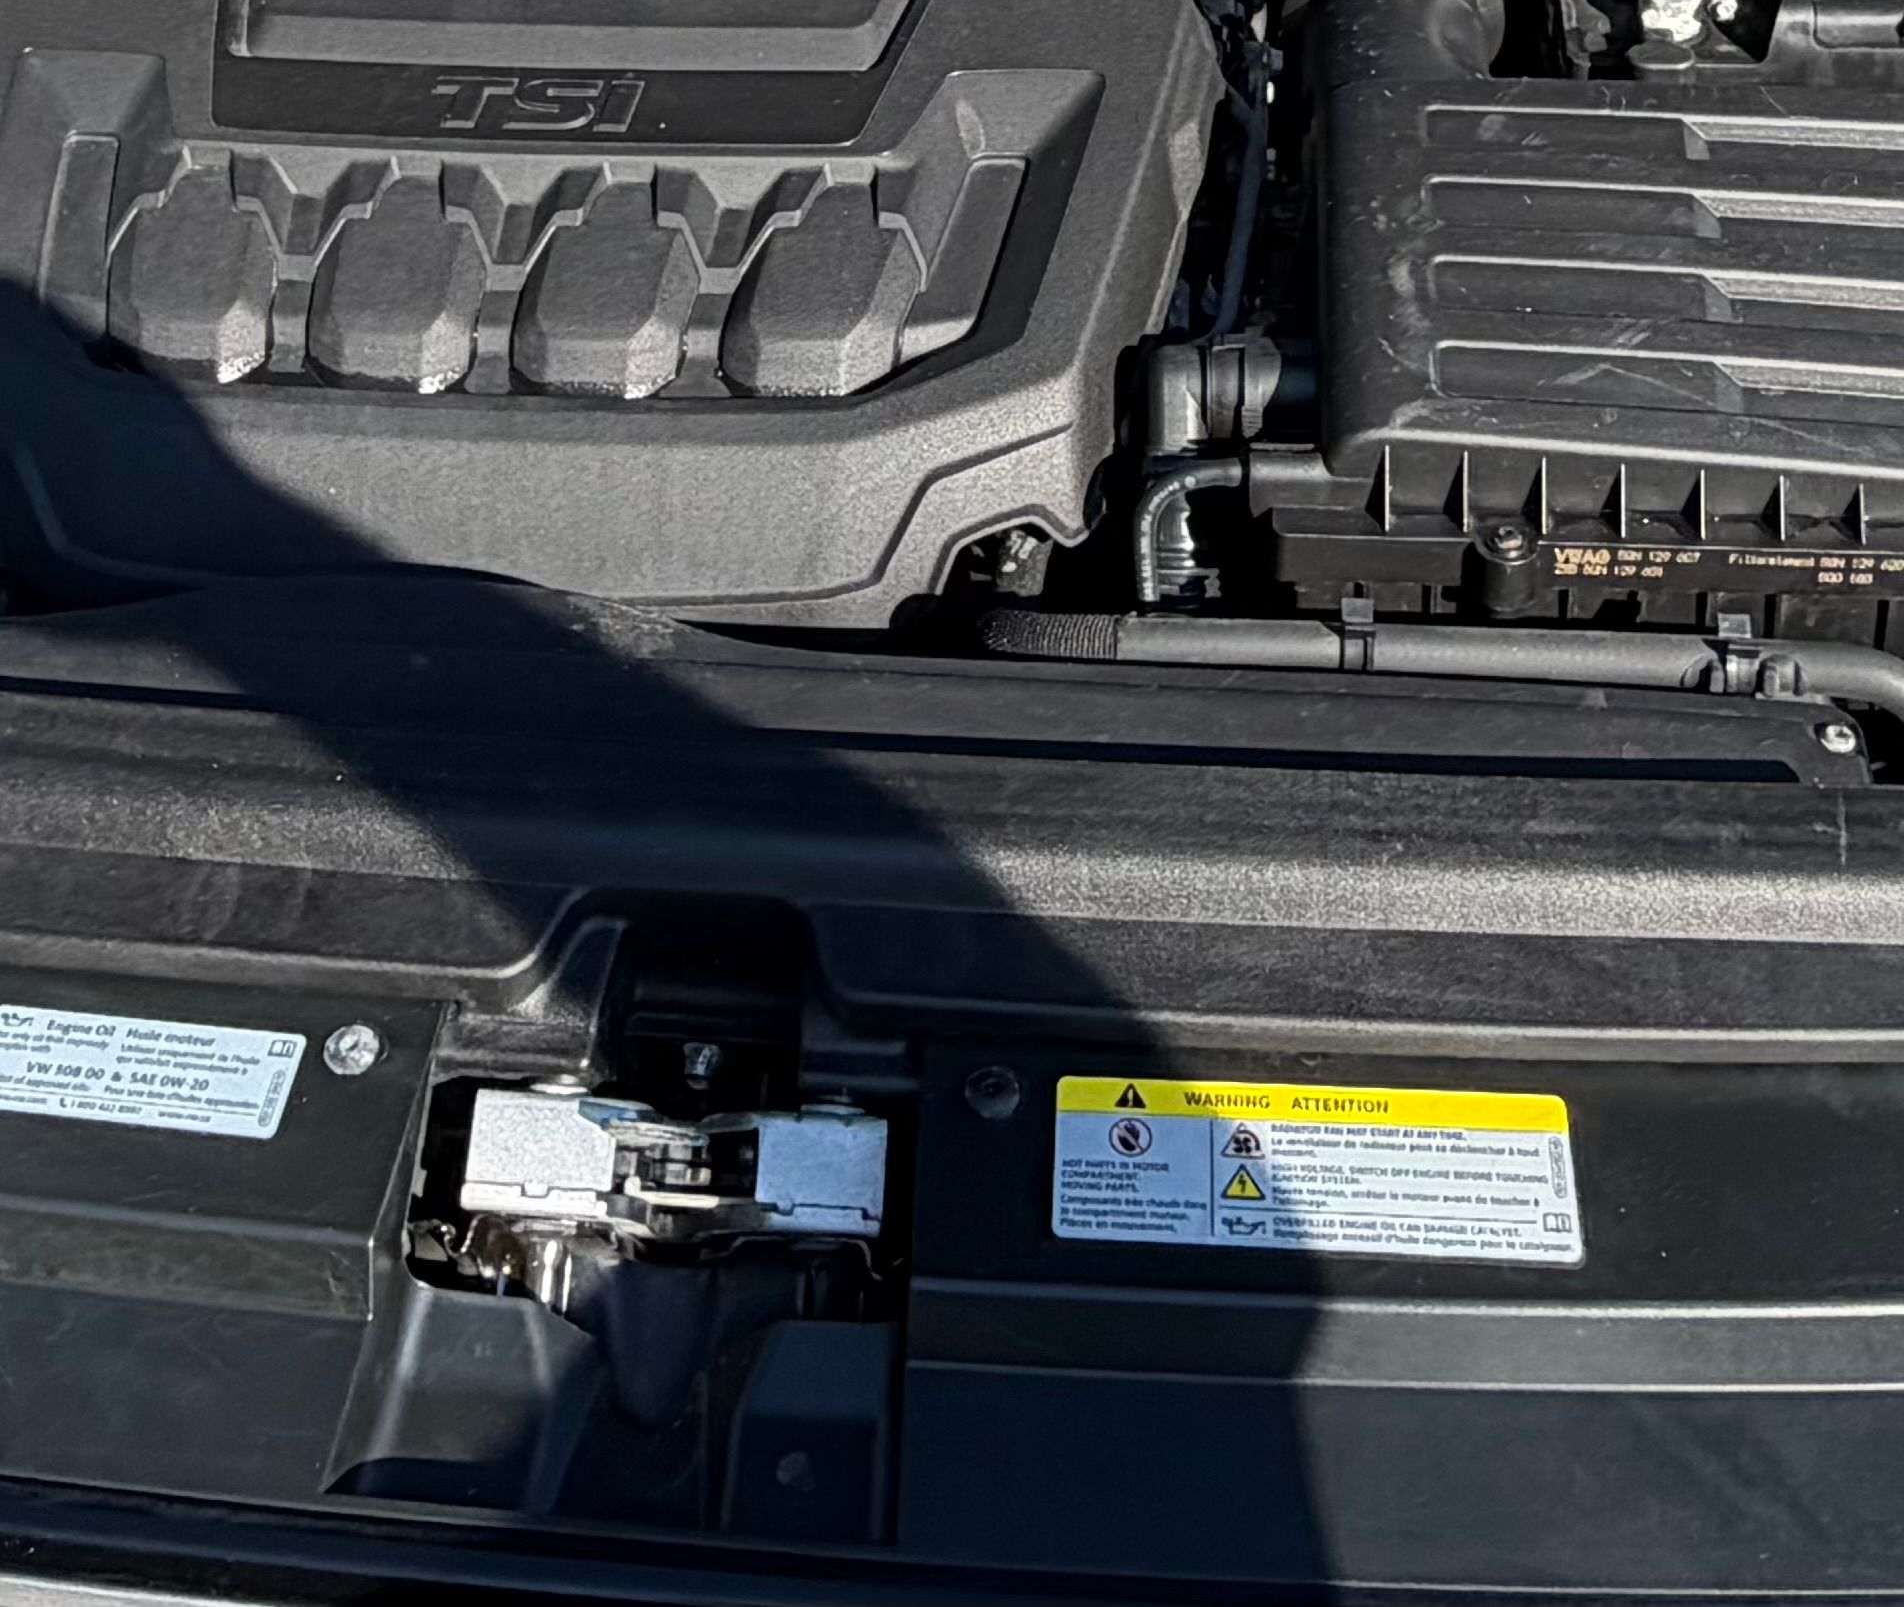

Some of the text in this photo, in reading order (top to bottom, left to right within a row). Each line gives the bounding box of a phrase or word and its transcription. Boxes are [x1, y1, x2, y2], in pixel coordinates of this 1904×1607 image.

[432, 76, 646, 133] TSI
[47, 1019, 116, 1037] Engine Oil
[127, 1027, 217, 1047] Huile moteur
[26, 1061, 53, 1075] VW
[54, 1064, 83, 1078] 508
[85, 1067, 106, 1080] 00
[129, 1071, 158, 1086] SAE
[159, 1075, 210, 1091] 0W-20
[1184, 1091, 1390, 1115] WARNING ATTENTION
[1084, 1160, 1117, 1170] PARTS
